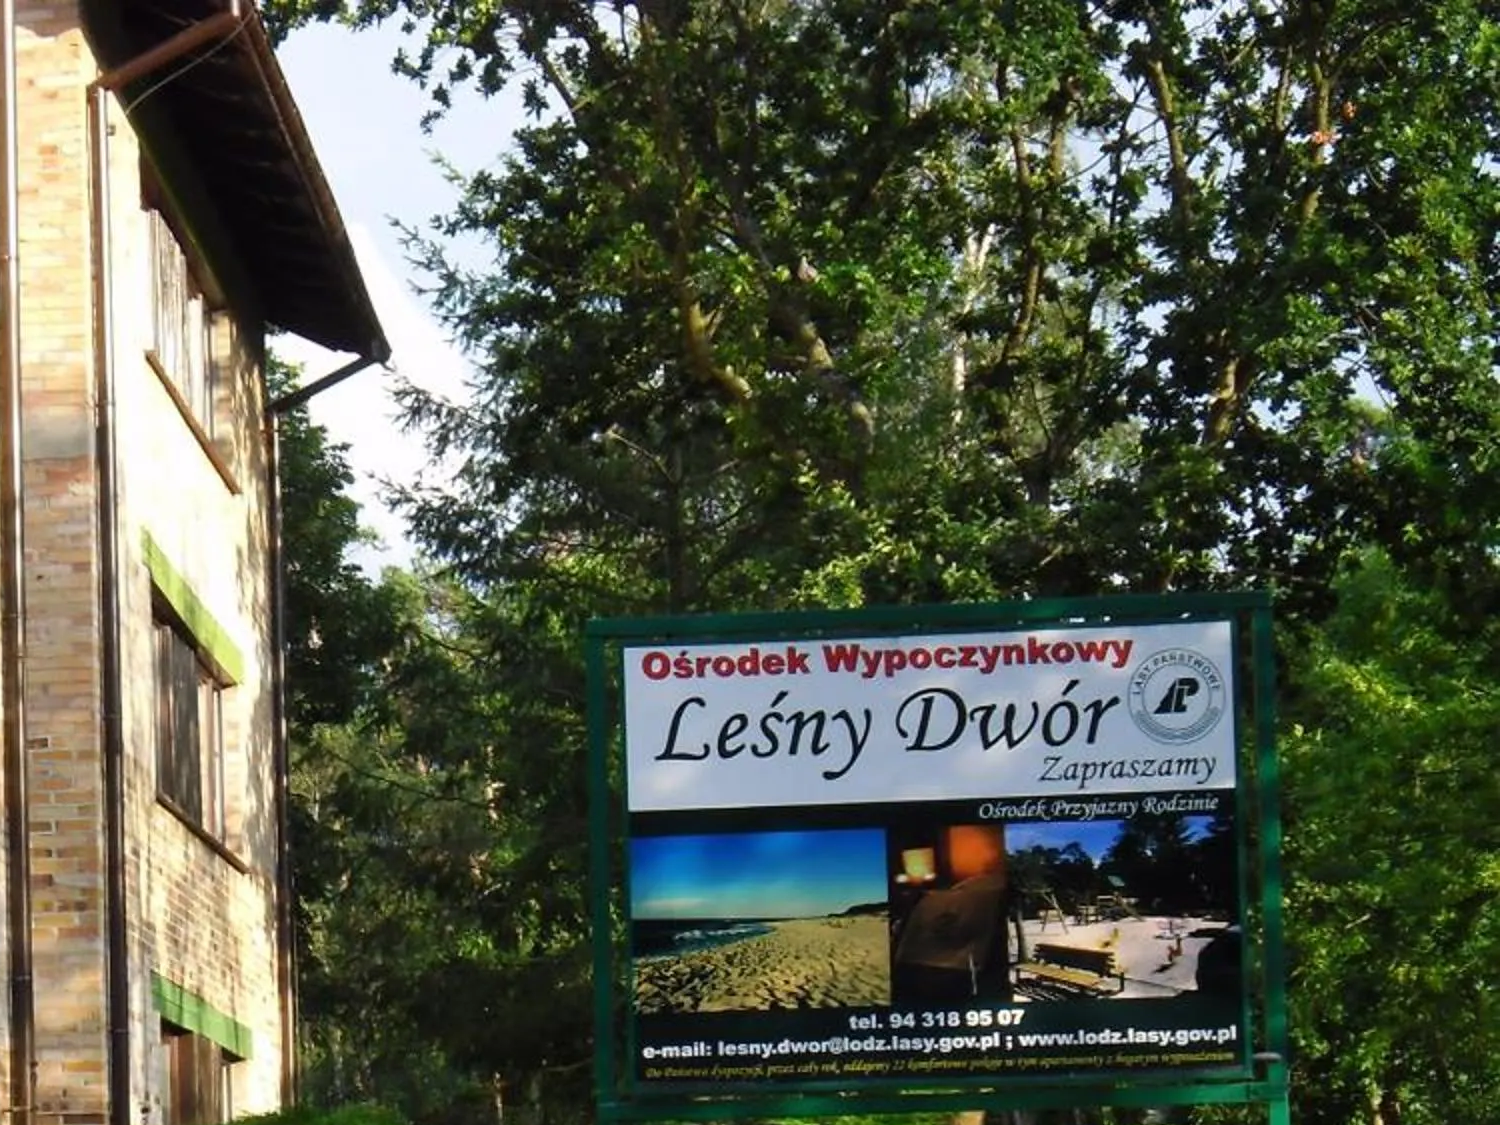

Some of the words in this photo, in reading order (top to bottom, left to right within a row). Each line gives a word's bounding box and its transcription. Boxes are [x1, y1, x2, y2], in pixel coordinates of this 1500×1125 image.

[641, 647, 812, 681] Ośrodek
[822, 637, 1134, 680] Wypoczynkowy
[653, 690, 873, 781] Leśny
[895, 678, 1120, 752] Dwór
[1037, 754, 1218, 789] Zapraszamy
[978, 799, 1051, 820] Ośrodek
[1051, 798, 1139, 820] Przyjazny
[1141, 791, 1220, 814] Rodzinie
[849, 1013, 883, 1029] tel.
[889, 1012, 916, 1029] 94
[921, 1010, 961, 1028] 318
[965, 1009, 992, 1027] 95
[998, 1008, 1026, 1026] 07
[642, 1040, 713, 1060] e-mail:
[717, 1032, 1001, 1059] lesny.dwor@lodz.lasy.gov.pl
[1018, 1024, 1238, 1047] www.lodz.lasy.gov.pl
